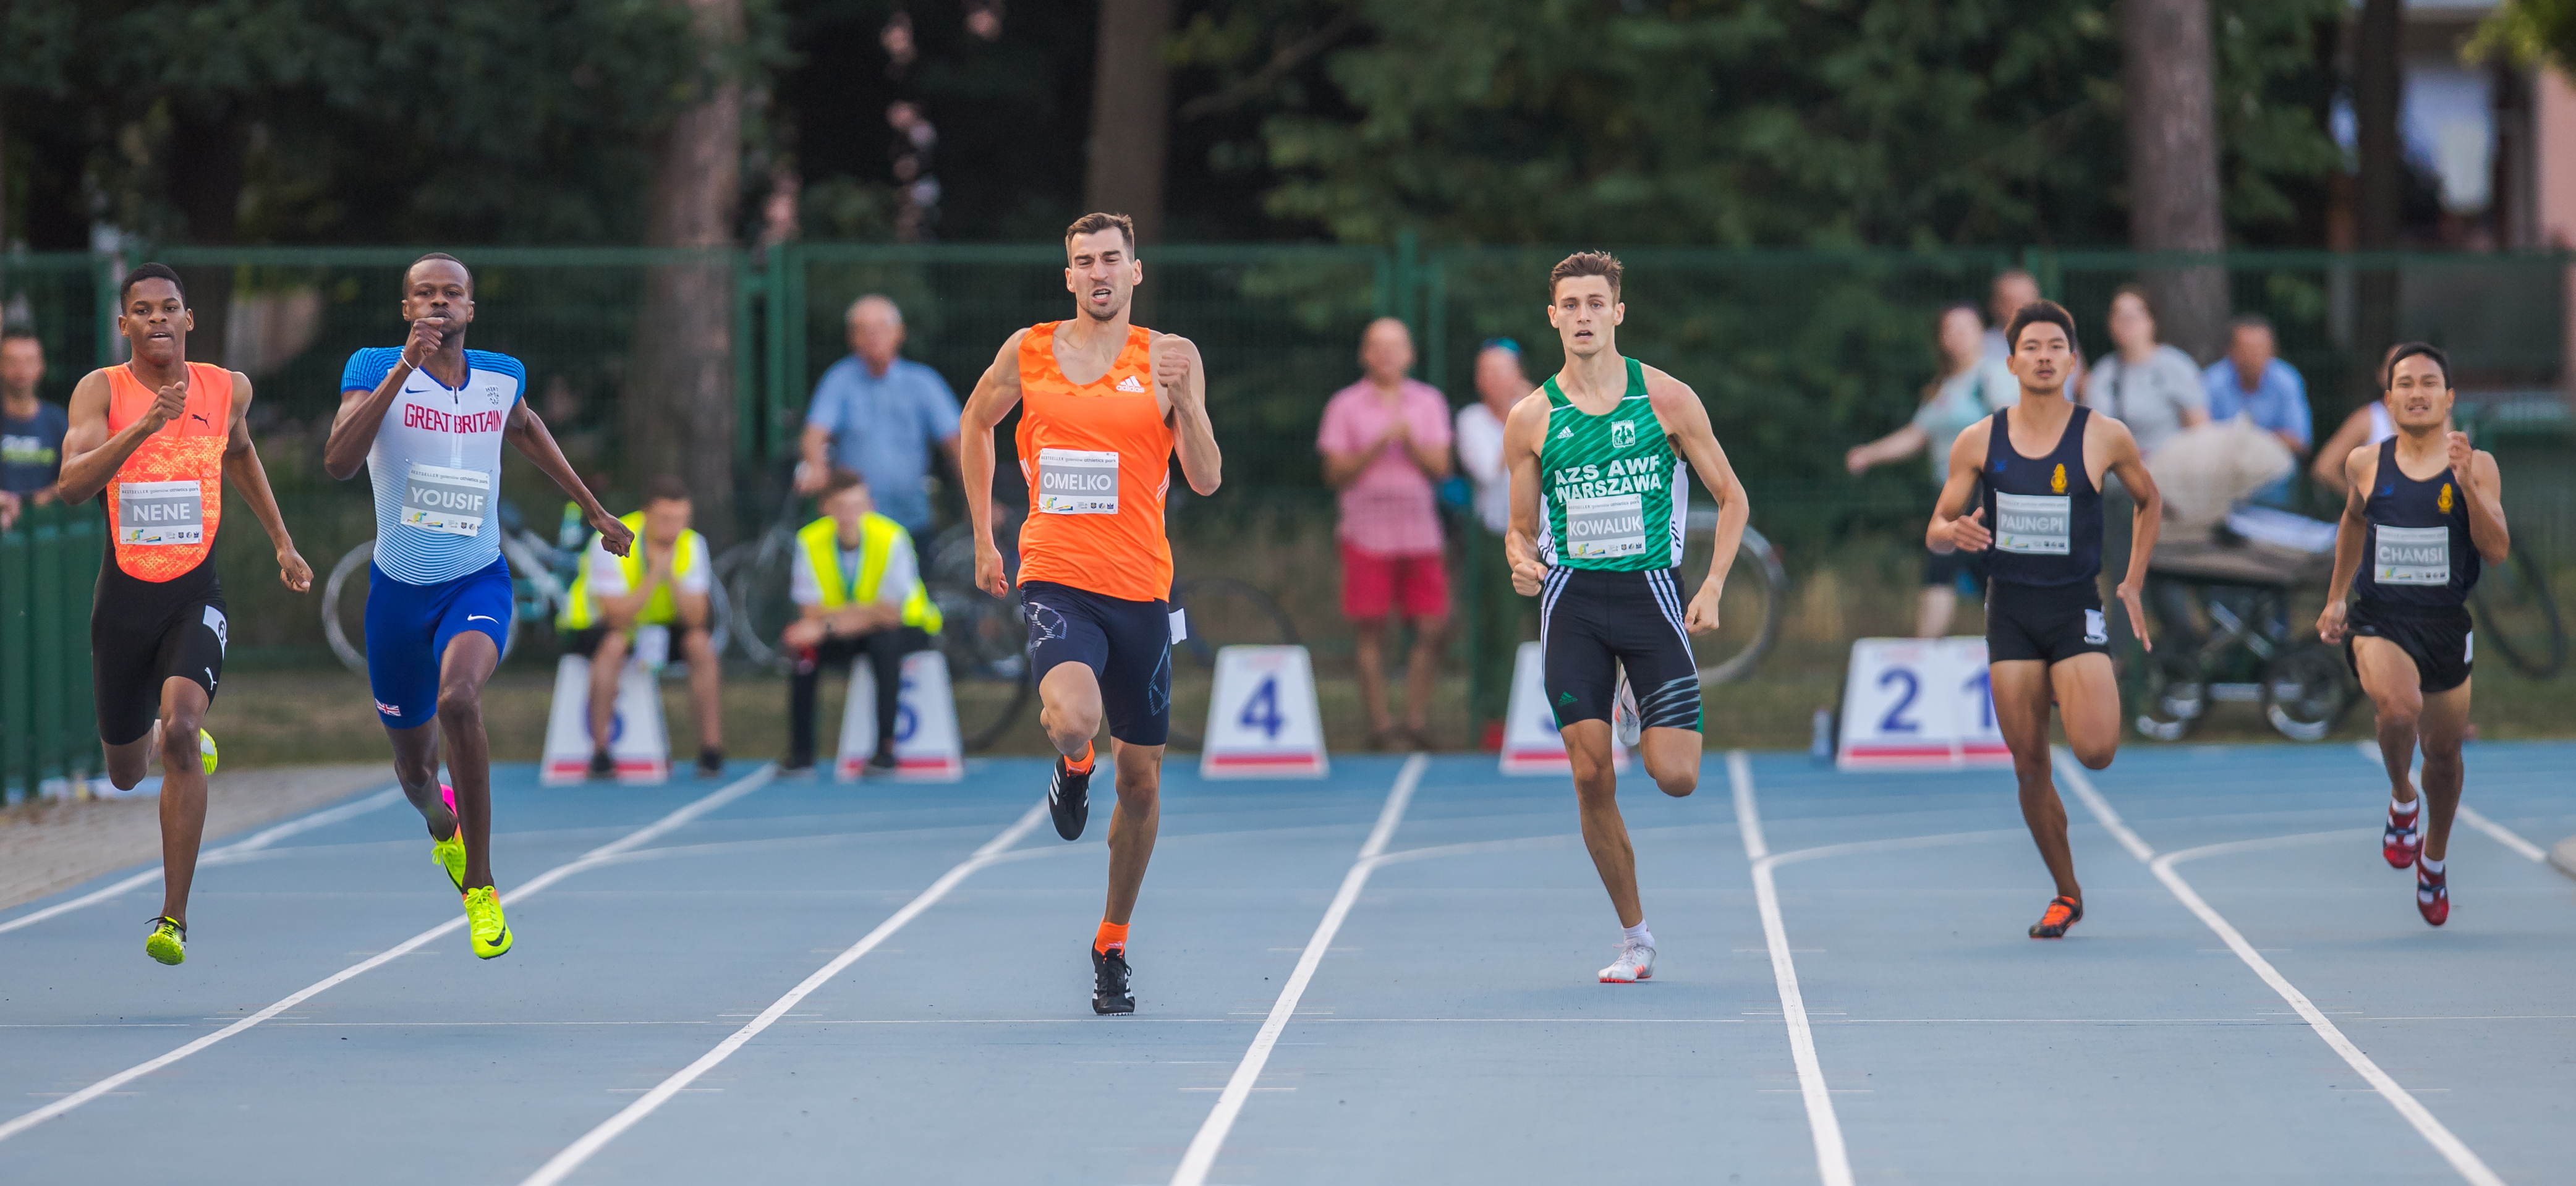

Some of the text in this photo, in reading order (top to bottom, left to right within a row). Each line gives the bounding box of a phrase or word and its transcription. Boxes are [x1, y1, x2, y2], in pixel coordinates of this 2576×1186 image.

[1116, 385, 1144, 393] adidas
[404, 403, 503, 434] GREAT BRITAIN
[410, 469, 439, 478] BESTSELLER
[1555, 454, 1660, 486] AZS AWF
[1044, 472, 1112, 491] OMELKO
[1555, 473, 1662, 504] WARSZAWA
[410, 486, 483, 512] YOUSIF
[133, 503, 190, 522] NENE
[2001, 514, 2064, 532] PAUNGPI
[1568, 515, 1643, 536] KOWALUK
[2379, 546, 2443, 563] CHAMSI
[218, 620, 226, 642] 6
[1239, 674, 1286, 739] 4
[1878, 666, 1921, 732] 2
[1962, 669, 1992, 729] 1
